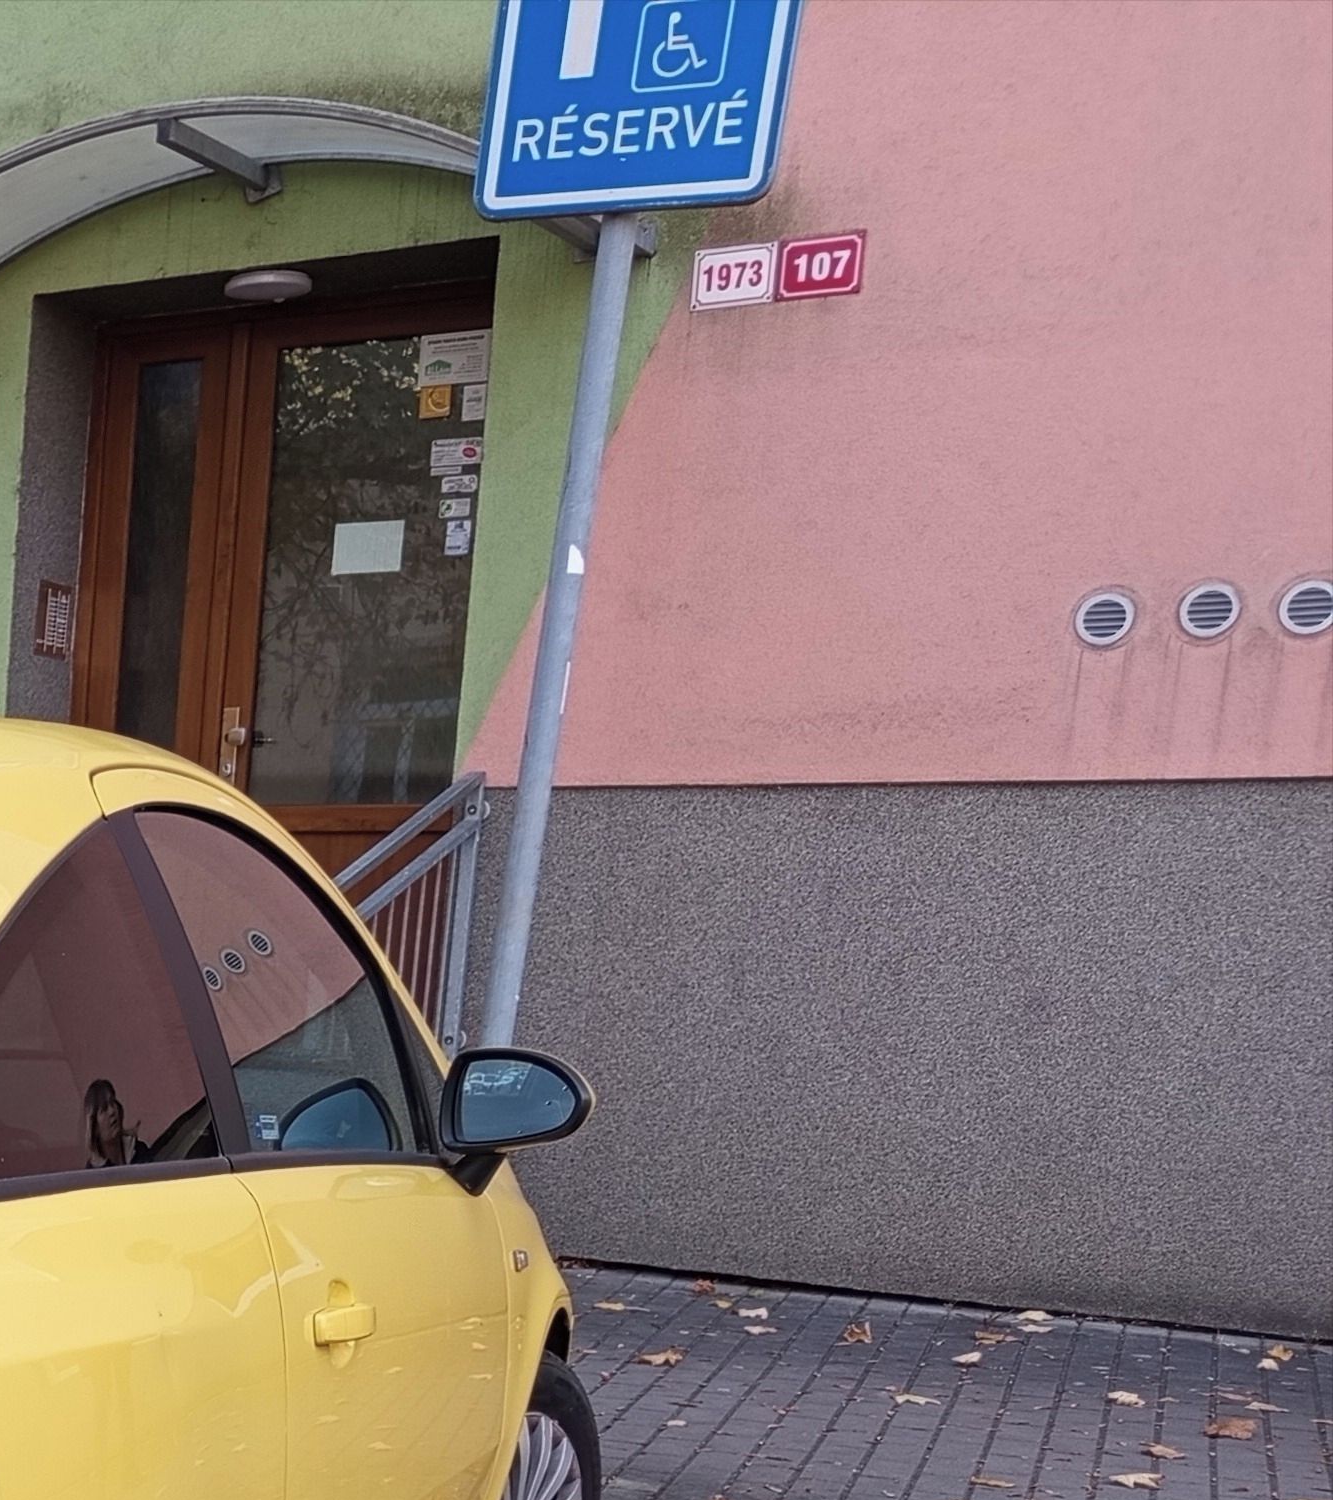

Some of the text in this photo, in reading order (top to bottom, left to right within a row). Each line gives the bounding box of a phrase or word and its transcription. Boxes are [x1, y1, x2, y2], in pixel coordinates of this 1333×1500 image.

[511, 89, 749, 162] RÉSERVÉ
[702, 259, 764, 293] 1973
[793, 249, 852, 283] 107
